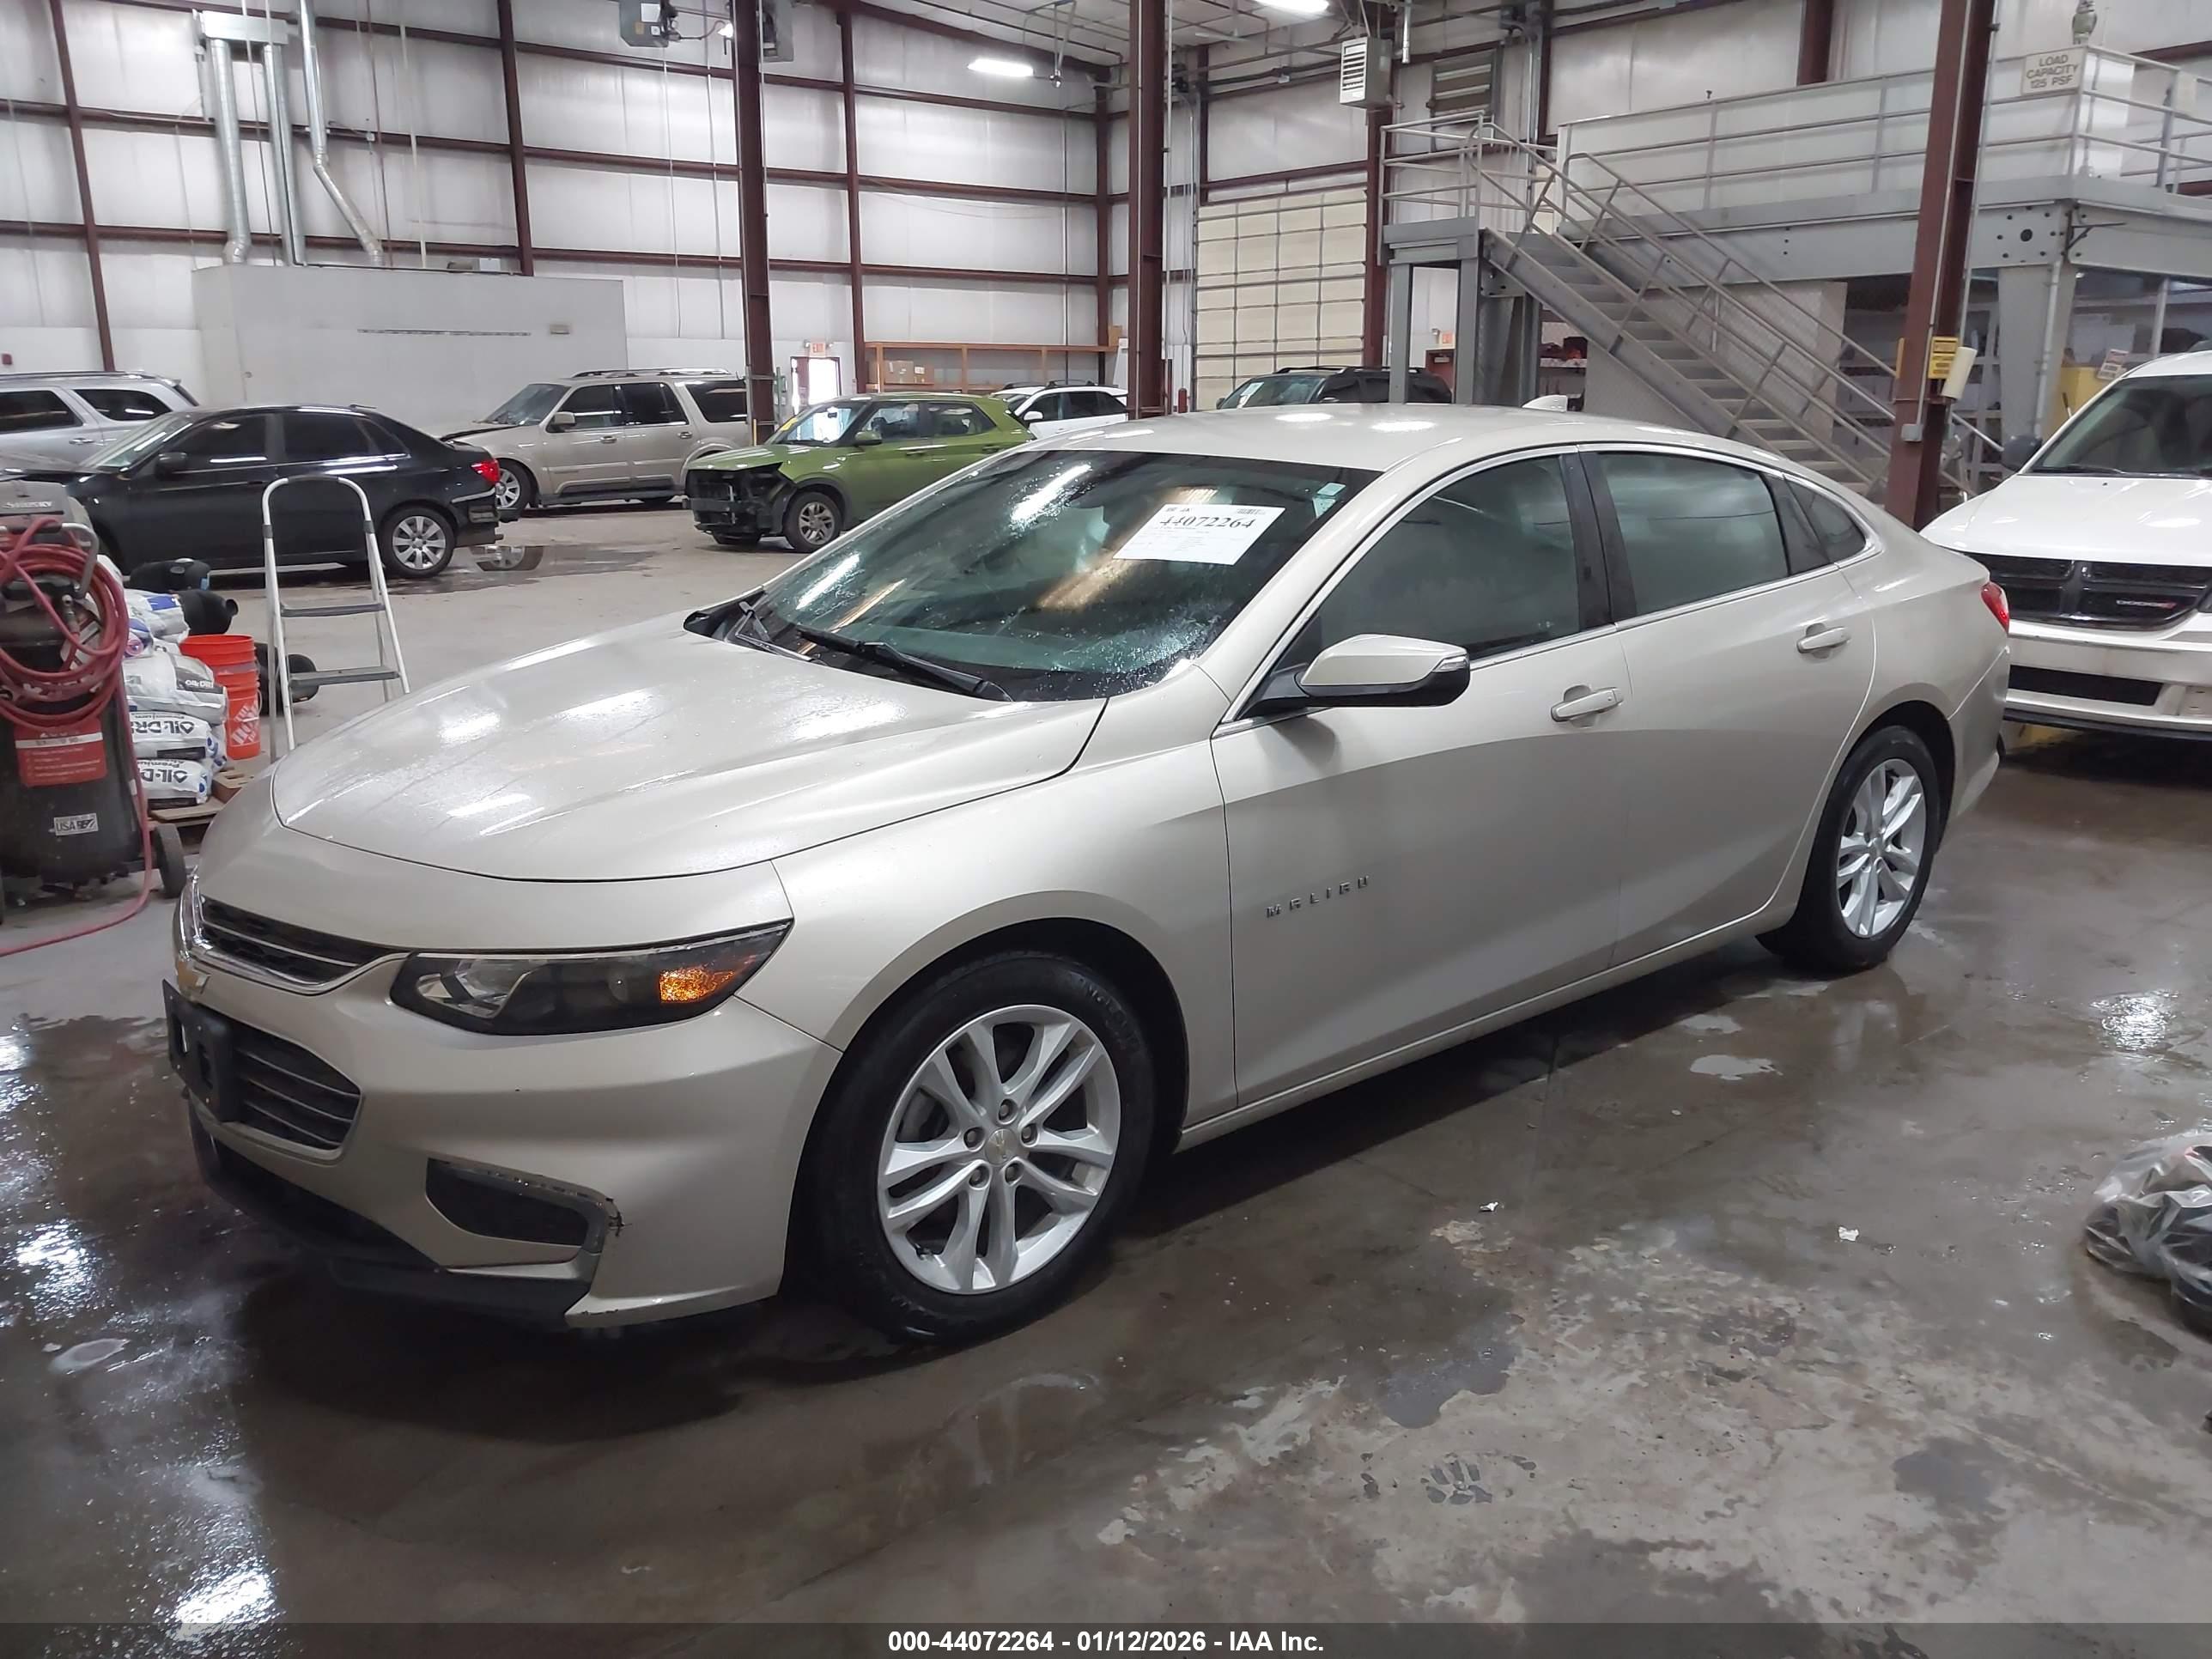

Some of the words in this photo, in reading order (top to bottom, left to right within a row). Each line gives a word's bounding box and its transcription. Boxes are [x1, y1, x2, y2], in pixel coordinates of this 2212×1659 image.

[2039, 54, 2069, 67] LOAD
[2027, 64, 2078, 79] CAPACITY
[2030, 78, 2047, 88] 125
[2051, 75, 2073, 85] PSF
[1160, 515, 1256, 529] 44072264
[1266, 875, 1370, 919] MALIBU
